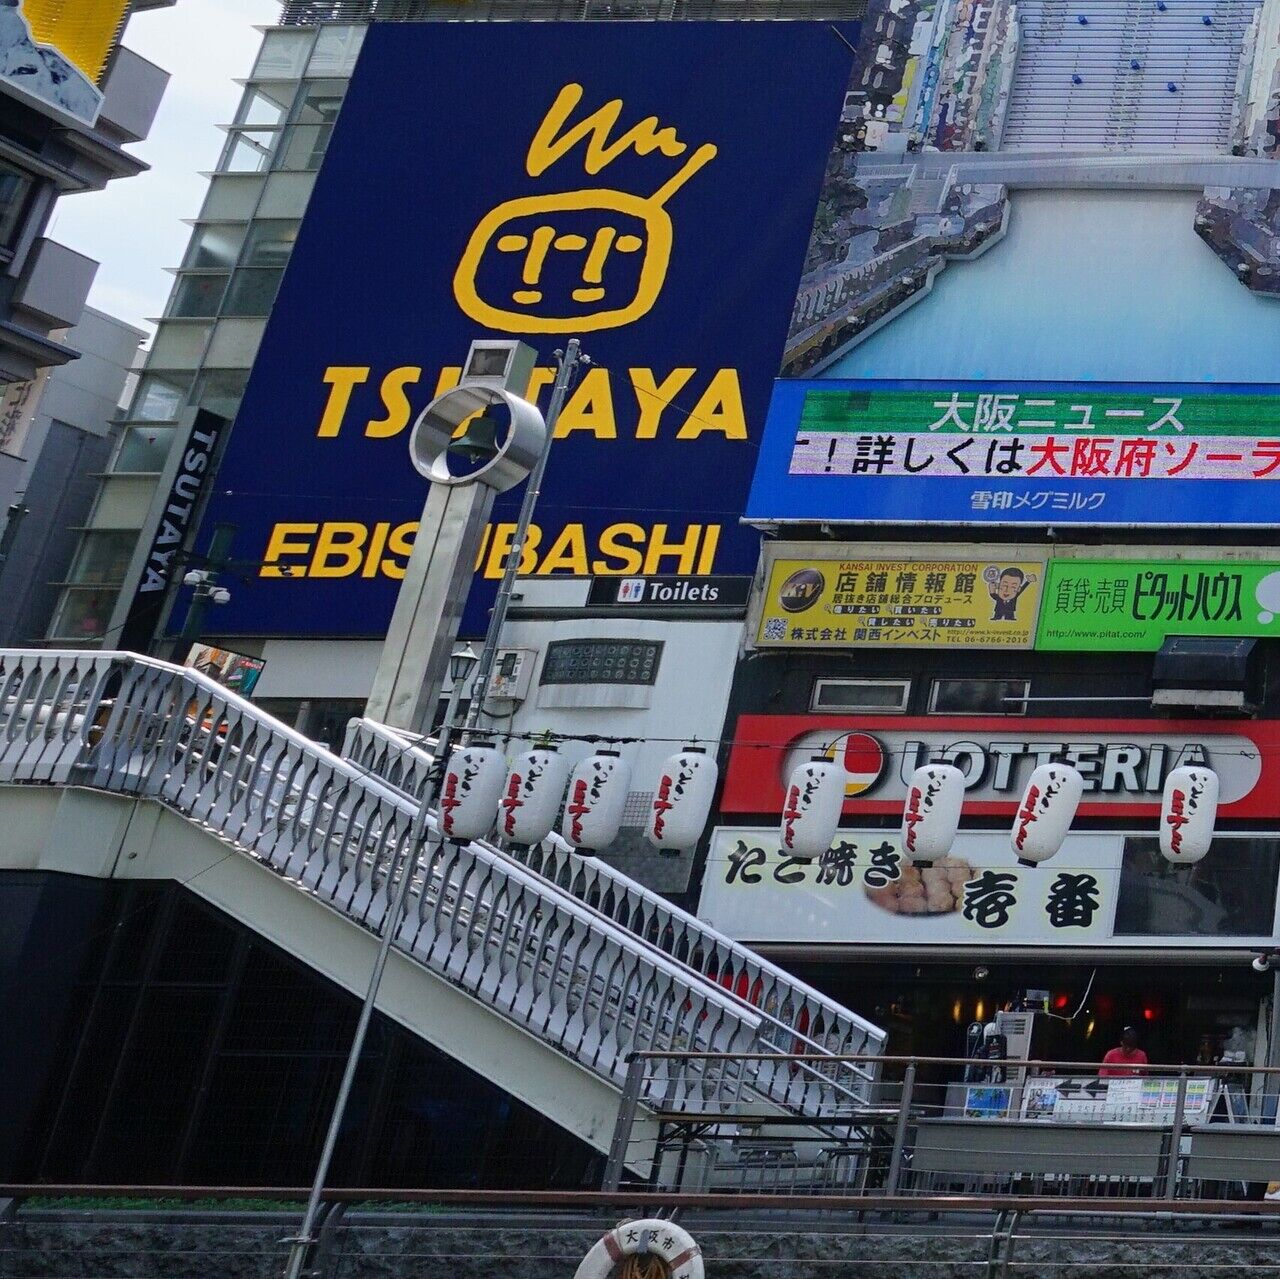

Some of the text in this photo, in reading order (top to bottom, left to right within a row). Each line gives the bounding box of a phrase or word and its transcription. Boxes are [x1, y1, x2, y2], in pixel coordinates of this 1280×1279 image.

[928, 392, 1185, 432] 大阪ニュース
[140, 430, 218, 593] TSUTAYA
[969, 490, 1106, 512] 雪印メグミルク
[835, 572, 977, 593] 店舗情報館
[839, 563, 979, 572] KANSAI INVEST CORPORATION
[649, 581, 720, 602] Toilets
[1132, 571, 1243, 621] ピタットハウス
[790, 627, 942, 641] 株式会社 関西インベスト
[725, 841, 902, 887] たこ焼き
[962, 871, 1100, 929] 壱番
